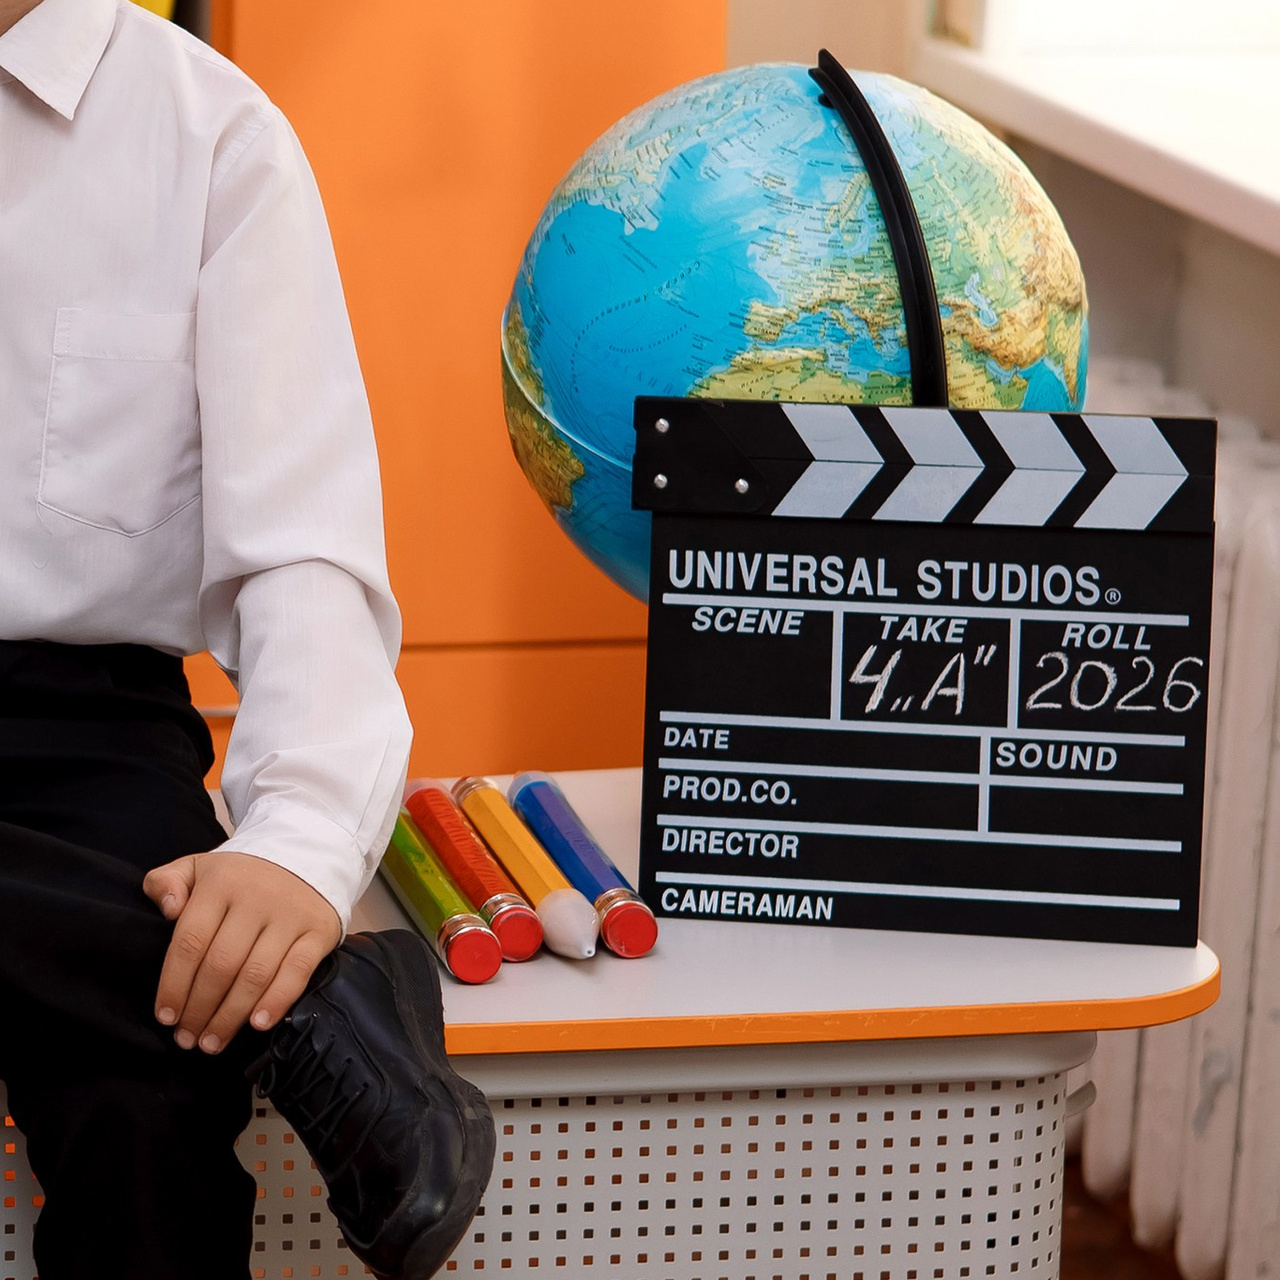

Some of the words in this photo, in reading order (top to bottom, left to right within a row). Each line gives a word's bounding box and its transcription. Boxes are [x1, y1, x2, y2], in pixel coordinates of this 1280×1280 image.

[669, 549, 898, 597] UNIVERSAL
[691, 606, 805, 636] SCENE
[879, 615, 969, 644] TAKE
[1061, 622, 1152, 651] ROLL
[1025, 651, 1204, 713] 2026
[663, 726, 730, 750] DATE
[995, 741, 1118, 772] SOUND
[662, 774, 797, 805] PROD.CO.
[661, 827, 800, 859] DIRECTOR
[661, 887, 834, 921] CAMERAMAN
